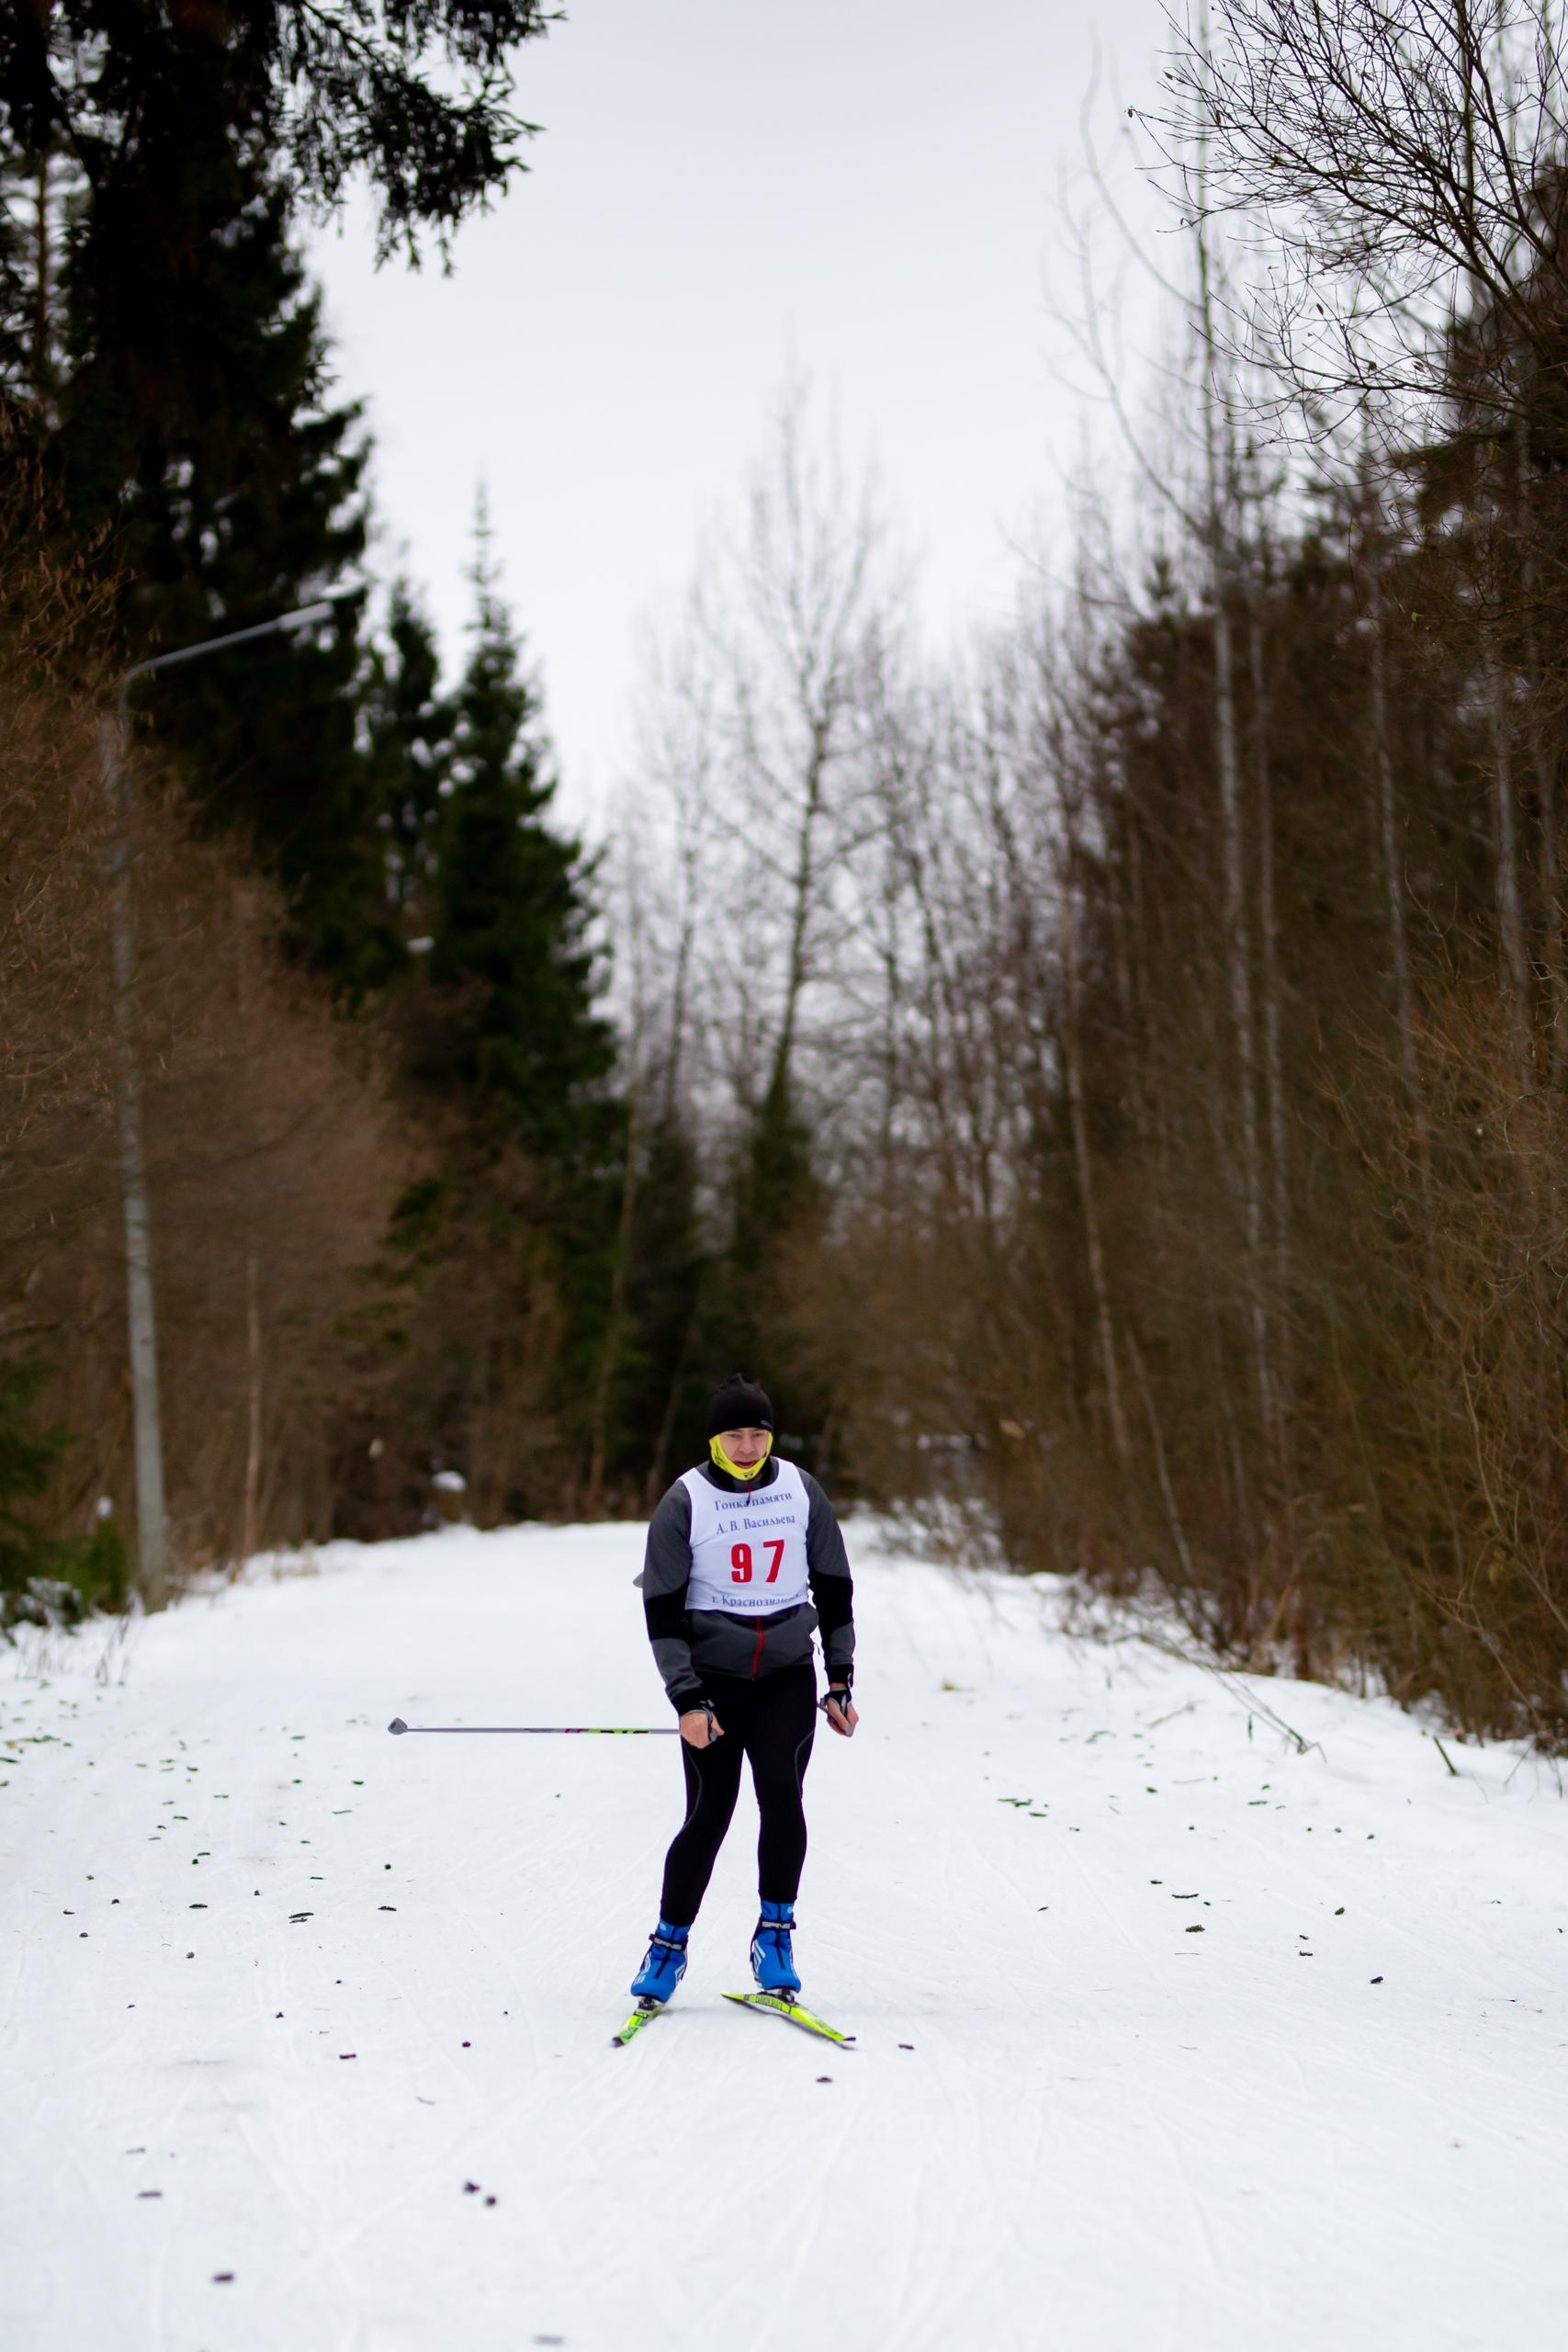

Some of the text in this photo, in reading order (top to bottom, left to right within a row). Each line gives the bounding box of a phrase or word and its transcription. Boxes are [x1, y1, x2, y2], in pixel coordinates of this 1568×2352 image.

[715, 1492, 792, 1510] Гонка памяти
[716, 1514, 795, 1534] А. В. Васильева
[730, 1539, 784, 1583] 97
